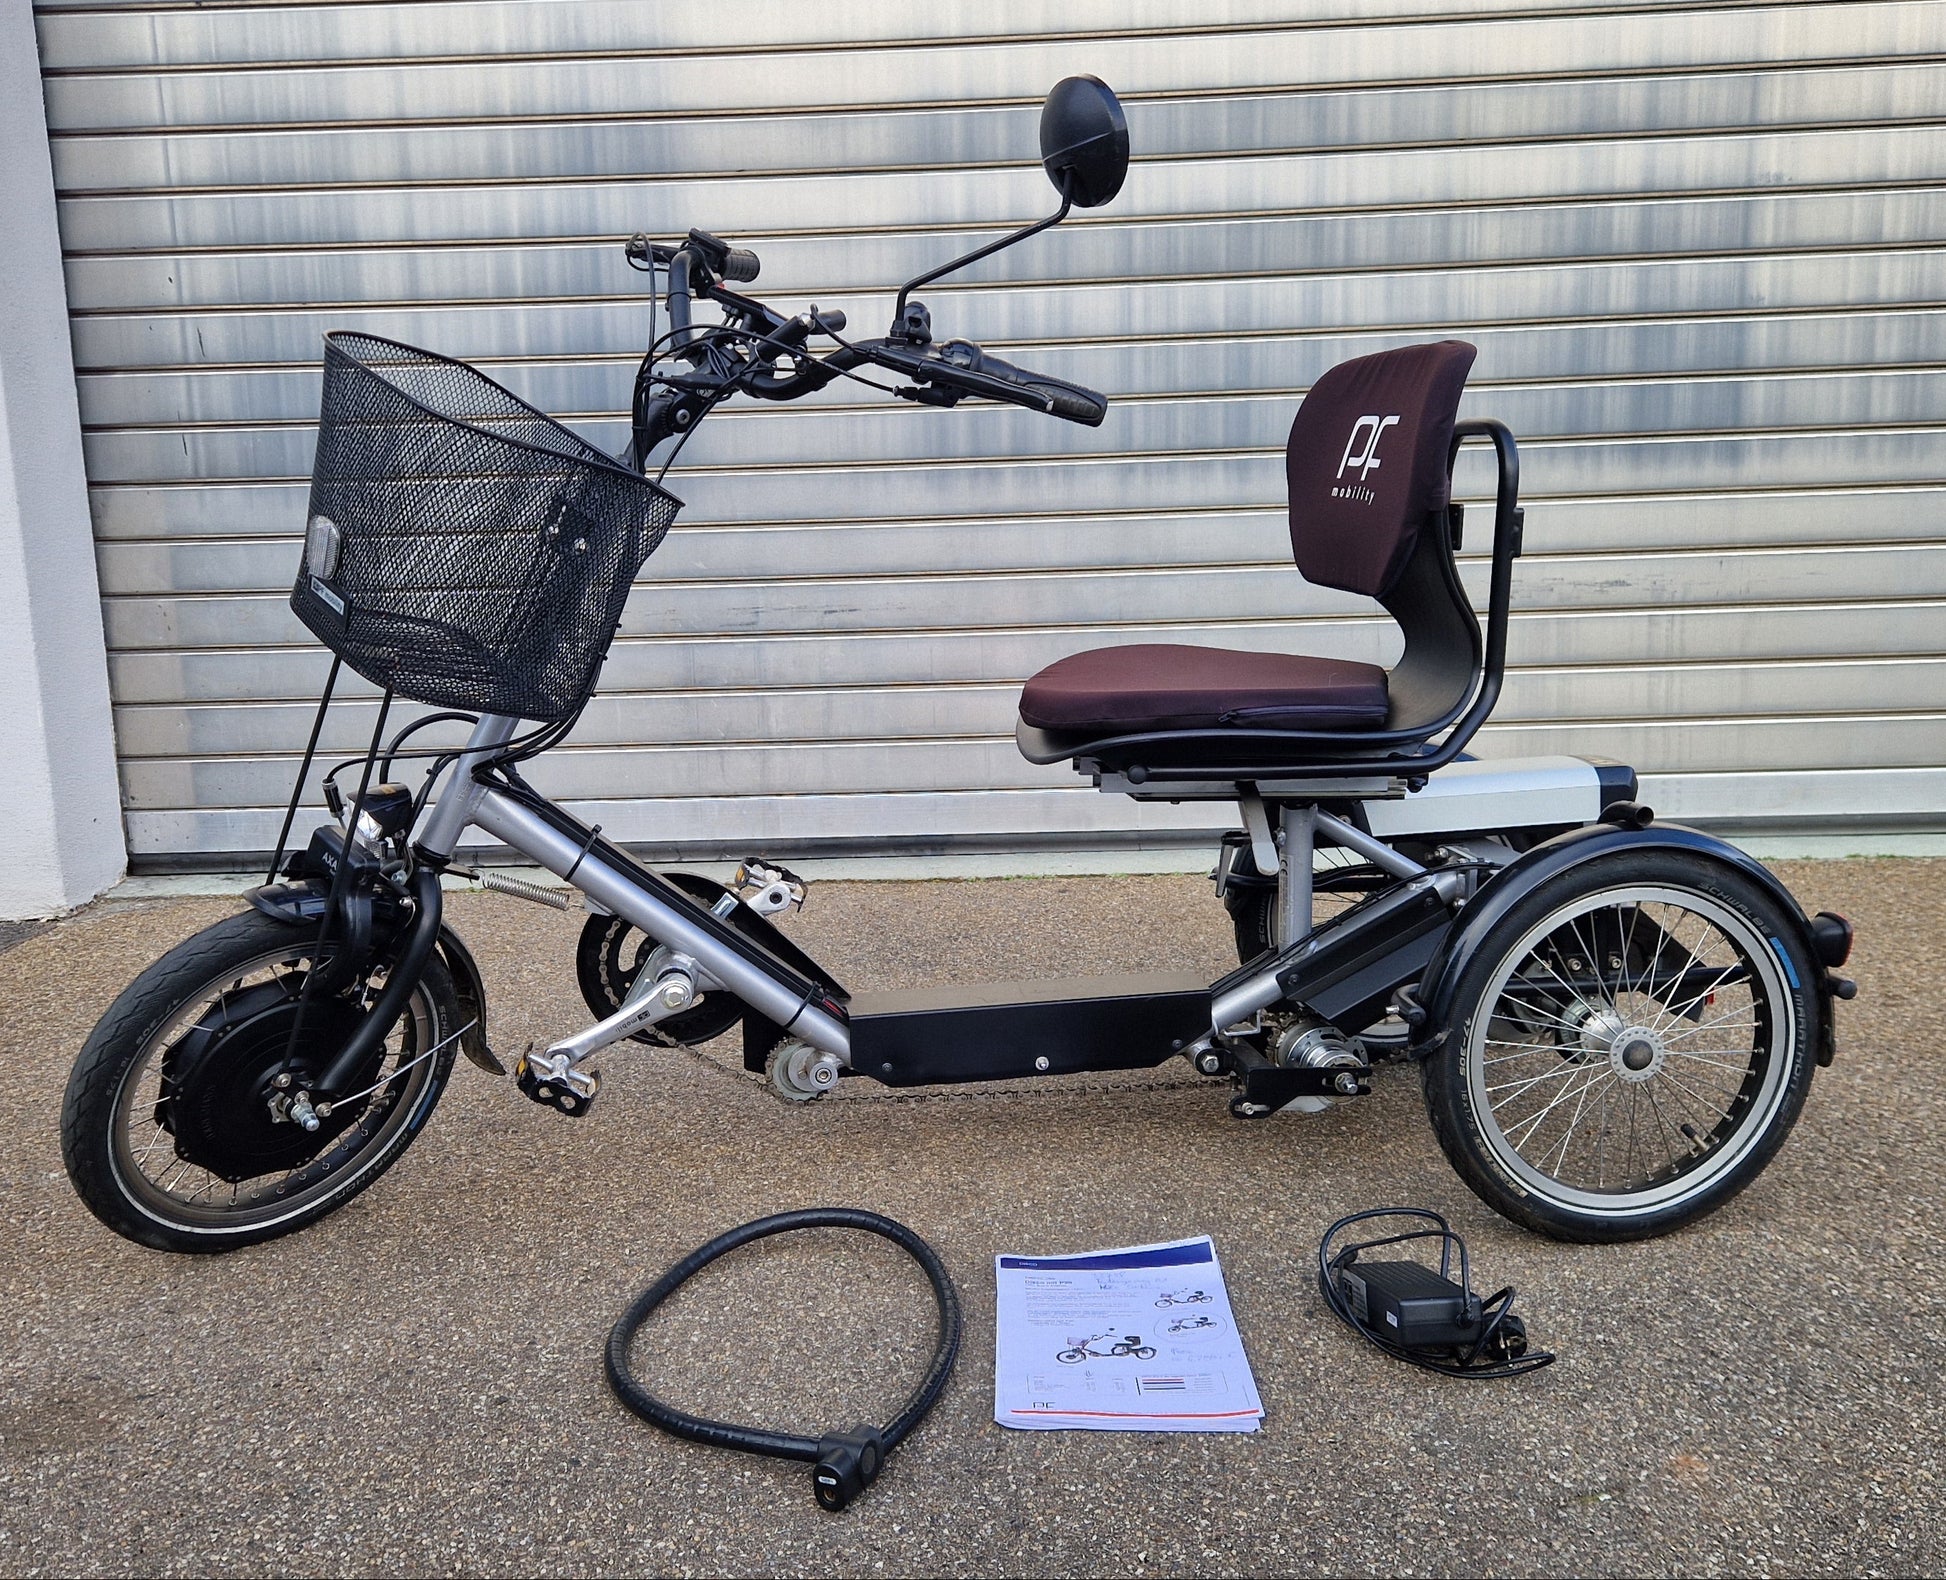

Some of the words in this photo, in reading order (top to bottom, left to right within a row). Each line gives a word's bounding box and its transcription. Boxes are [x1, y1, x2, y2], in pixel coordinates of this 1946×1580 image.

[1331, 484, 1375, 506] mobility
[321, 852, 338, 871] AXA
[1698, 881, 1771, 934] SCHWALBE
[1791, 994, 1807, 1089] MARATHON
